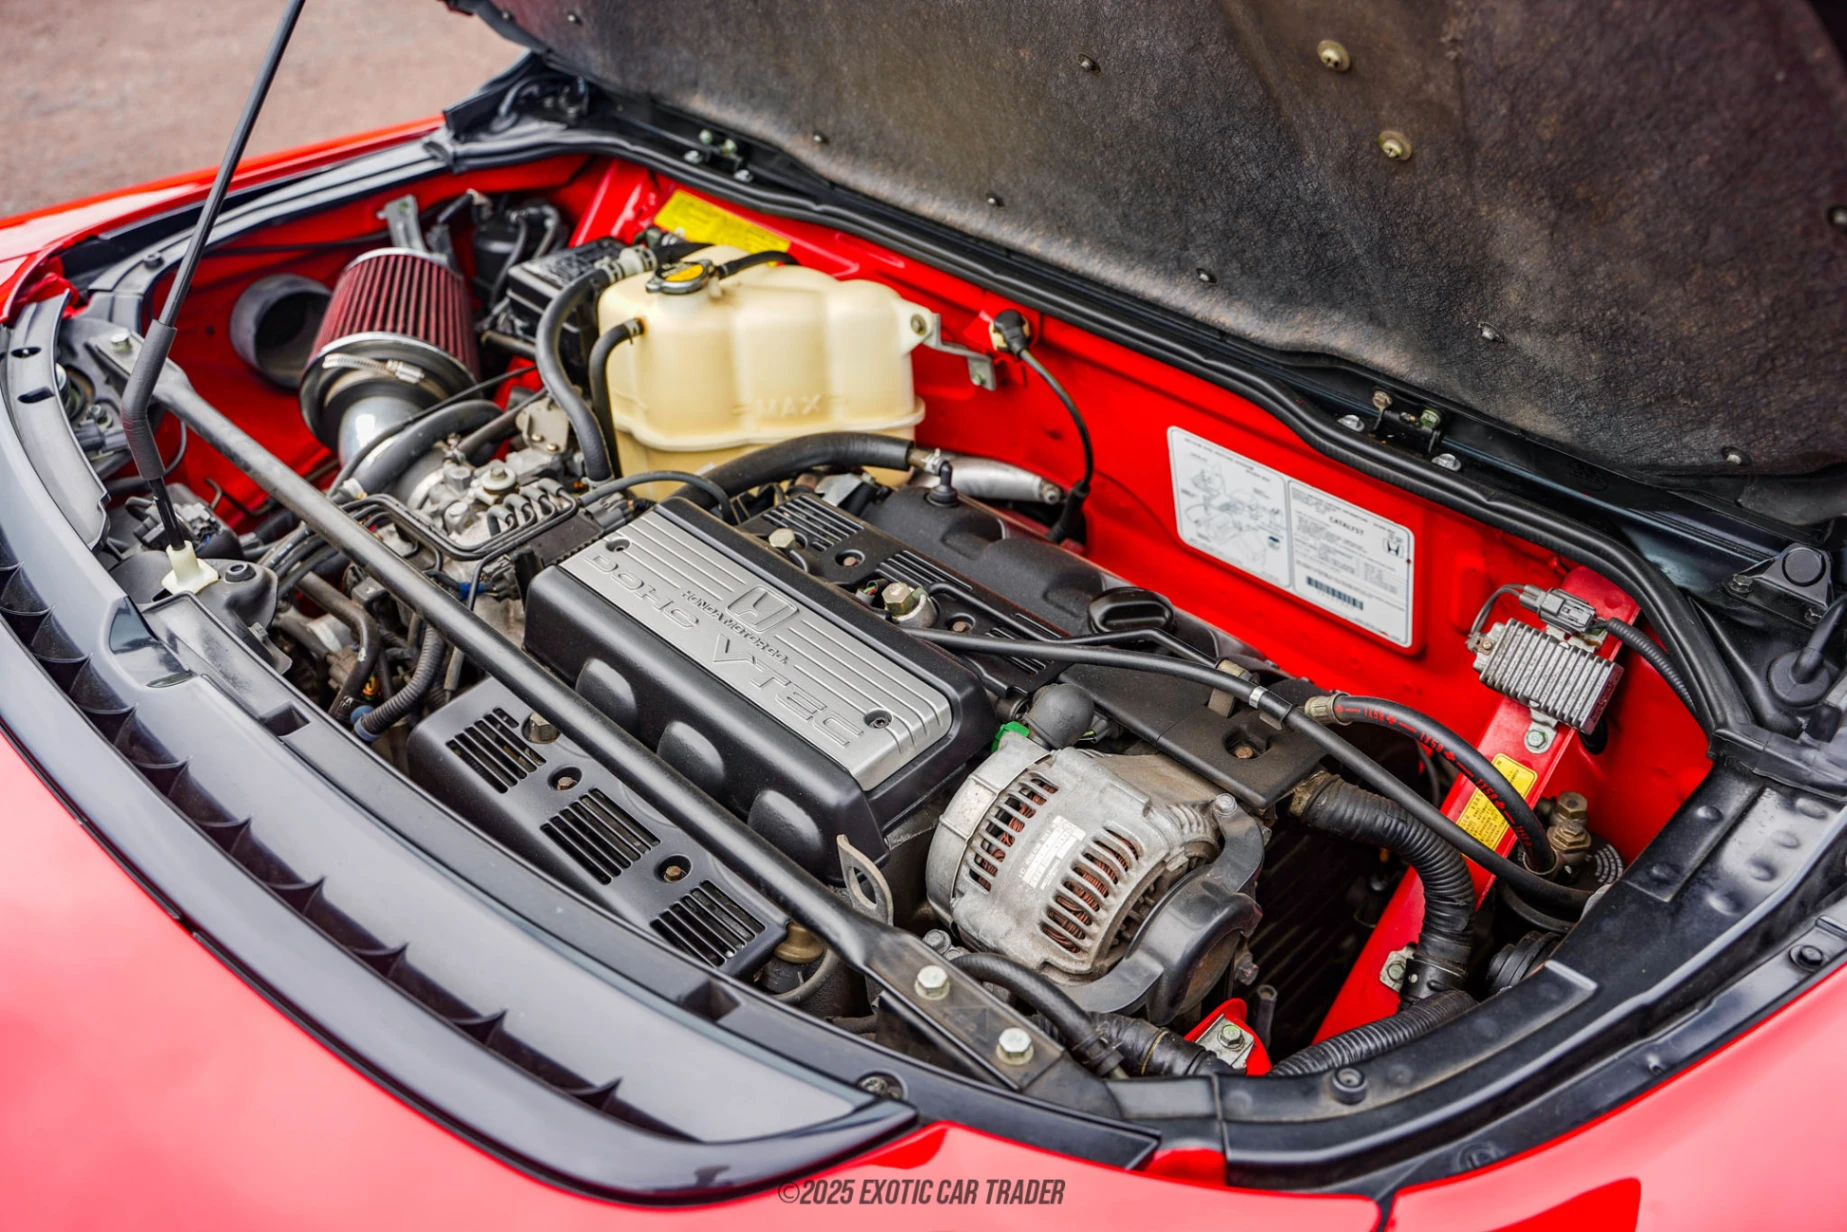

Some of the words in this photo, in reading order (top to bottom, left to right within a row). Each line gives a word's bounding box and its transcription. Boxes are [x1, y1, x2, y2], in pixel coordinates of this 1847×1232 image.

[755, 394, 821, 418] MAX
[1329, 515, 1365, 536] CATALYST
[681, 589, 724, 621] HONDA
[723, 617, 770, 653] MOTOR
[584, 554, 700, 630] DOHC
[712, 632, 864, 748] VTEC
